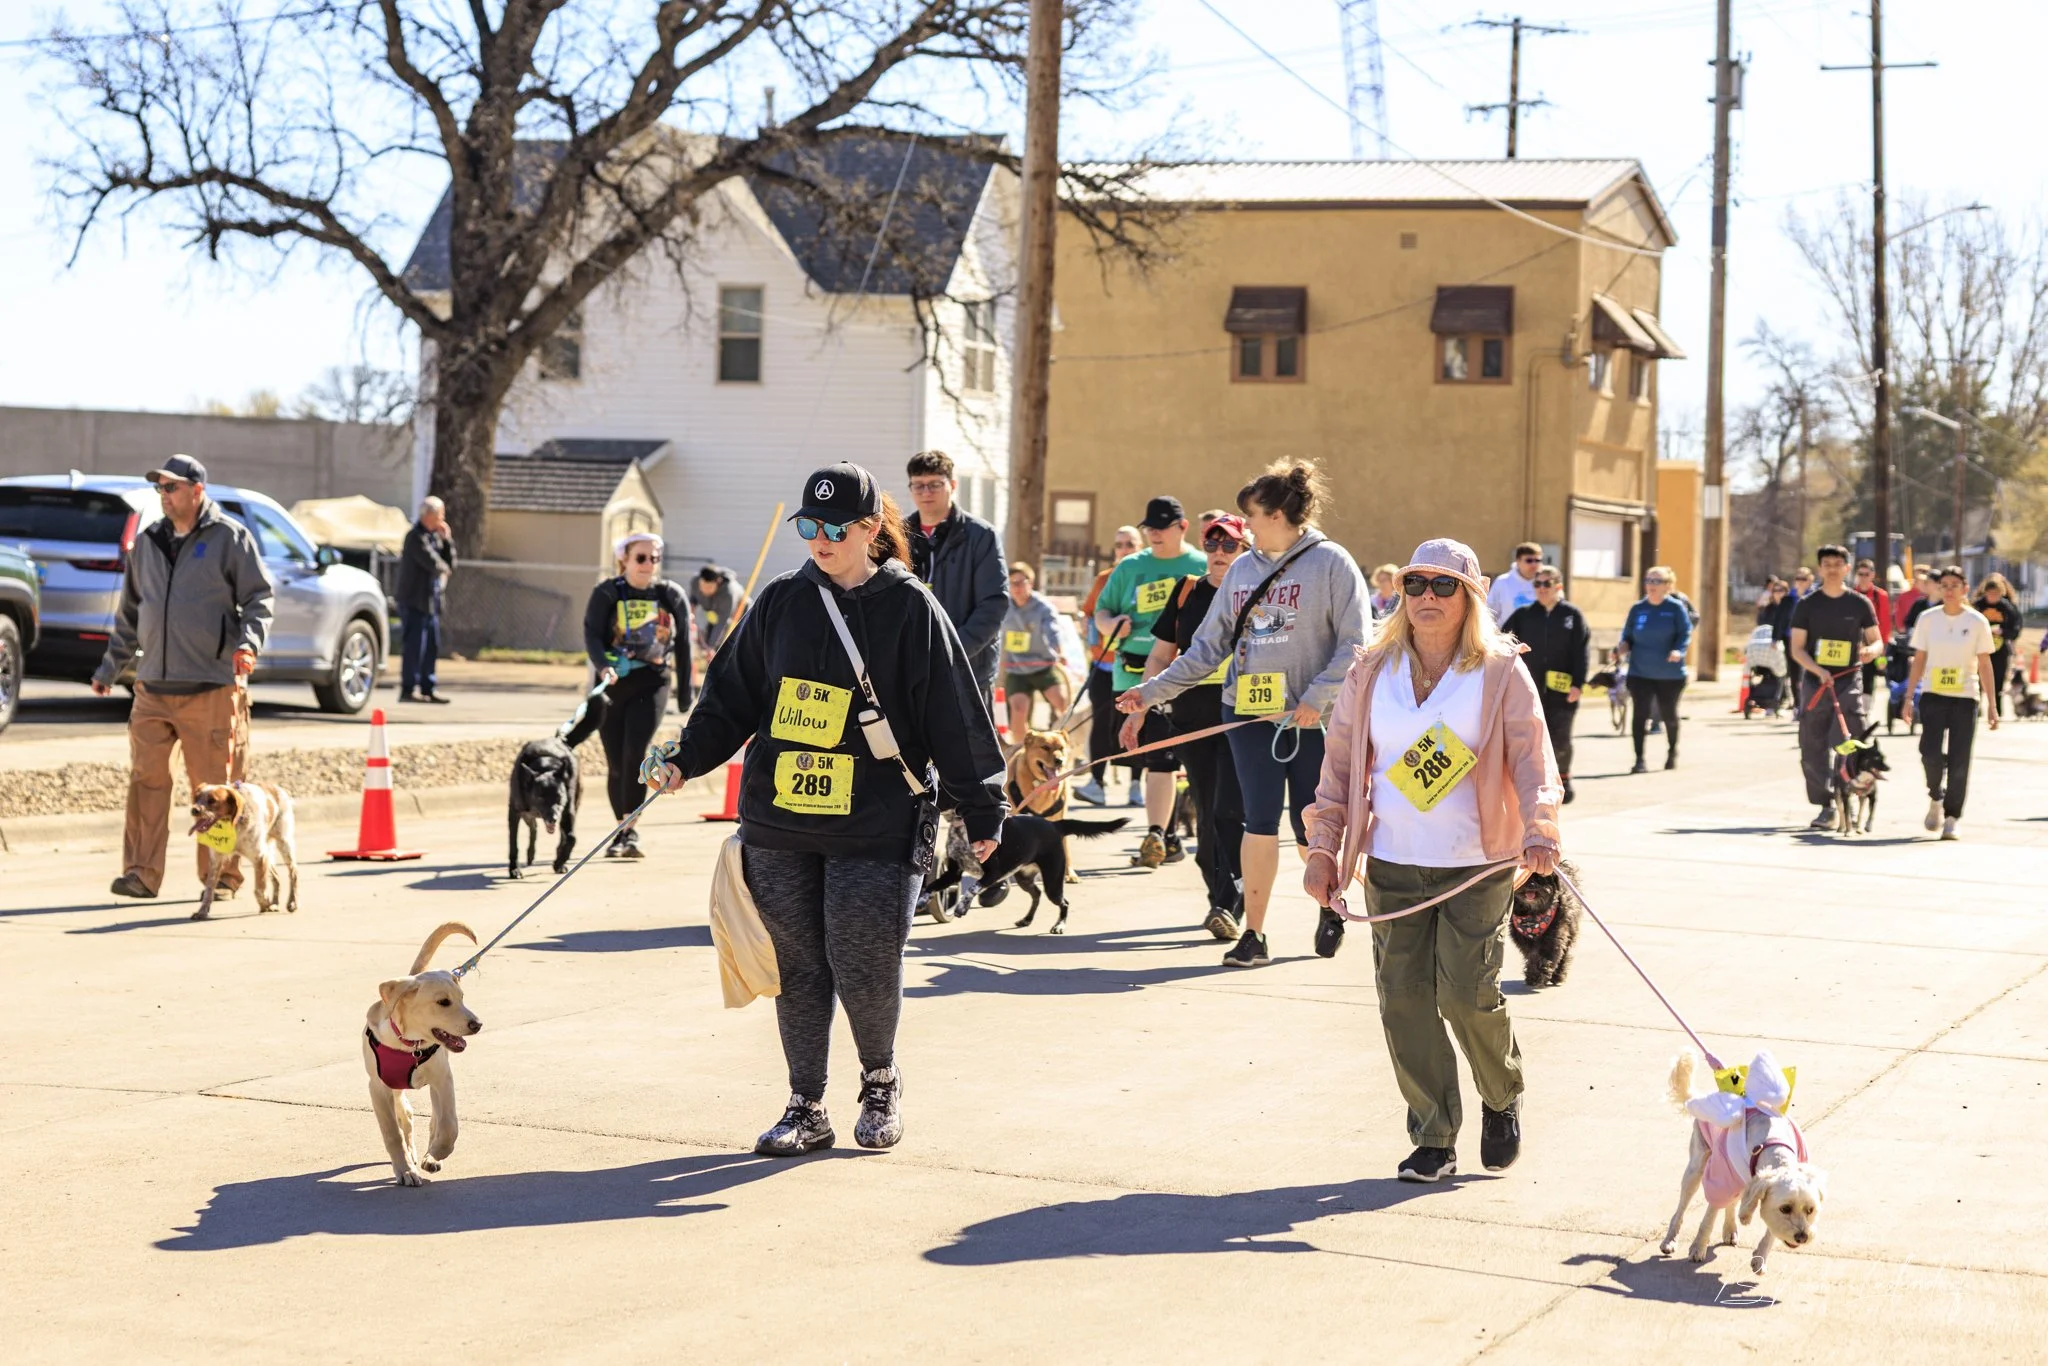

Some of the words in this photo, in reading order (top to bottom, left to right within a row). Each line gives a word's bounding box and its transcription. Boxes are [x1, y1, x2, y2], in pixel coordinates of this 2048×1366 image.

[1146, 590, 1167, 603] 263
[1232, 583, 1302, 617] DEVER
[1262, 675, 1272, 684] 5K
[813, 687, 831, 702] 5K
[1248, 687, 1272, 703] 379
[778, 705, 828, 730] Willow
[1417, 734, 1436, 753] 5K
[817, 756, 835, 770] 5K
[1413, 750, 1452, 790] 288
[791, 772, 832, 797] 289
